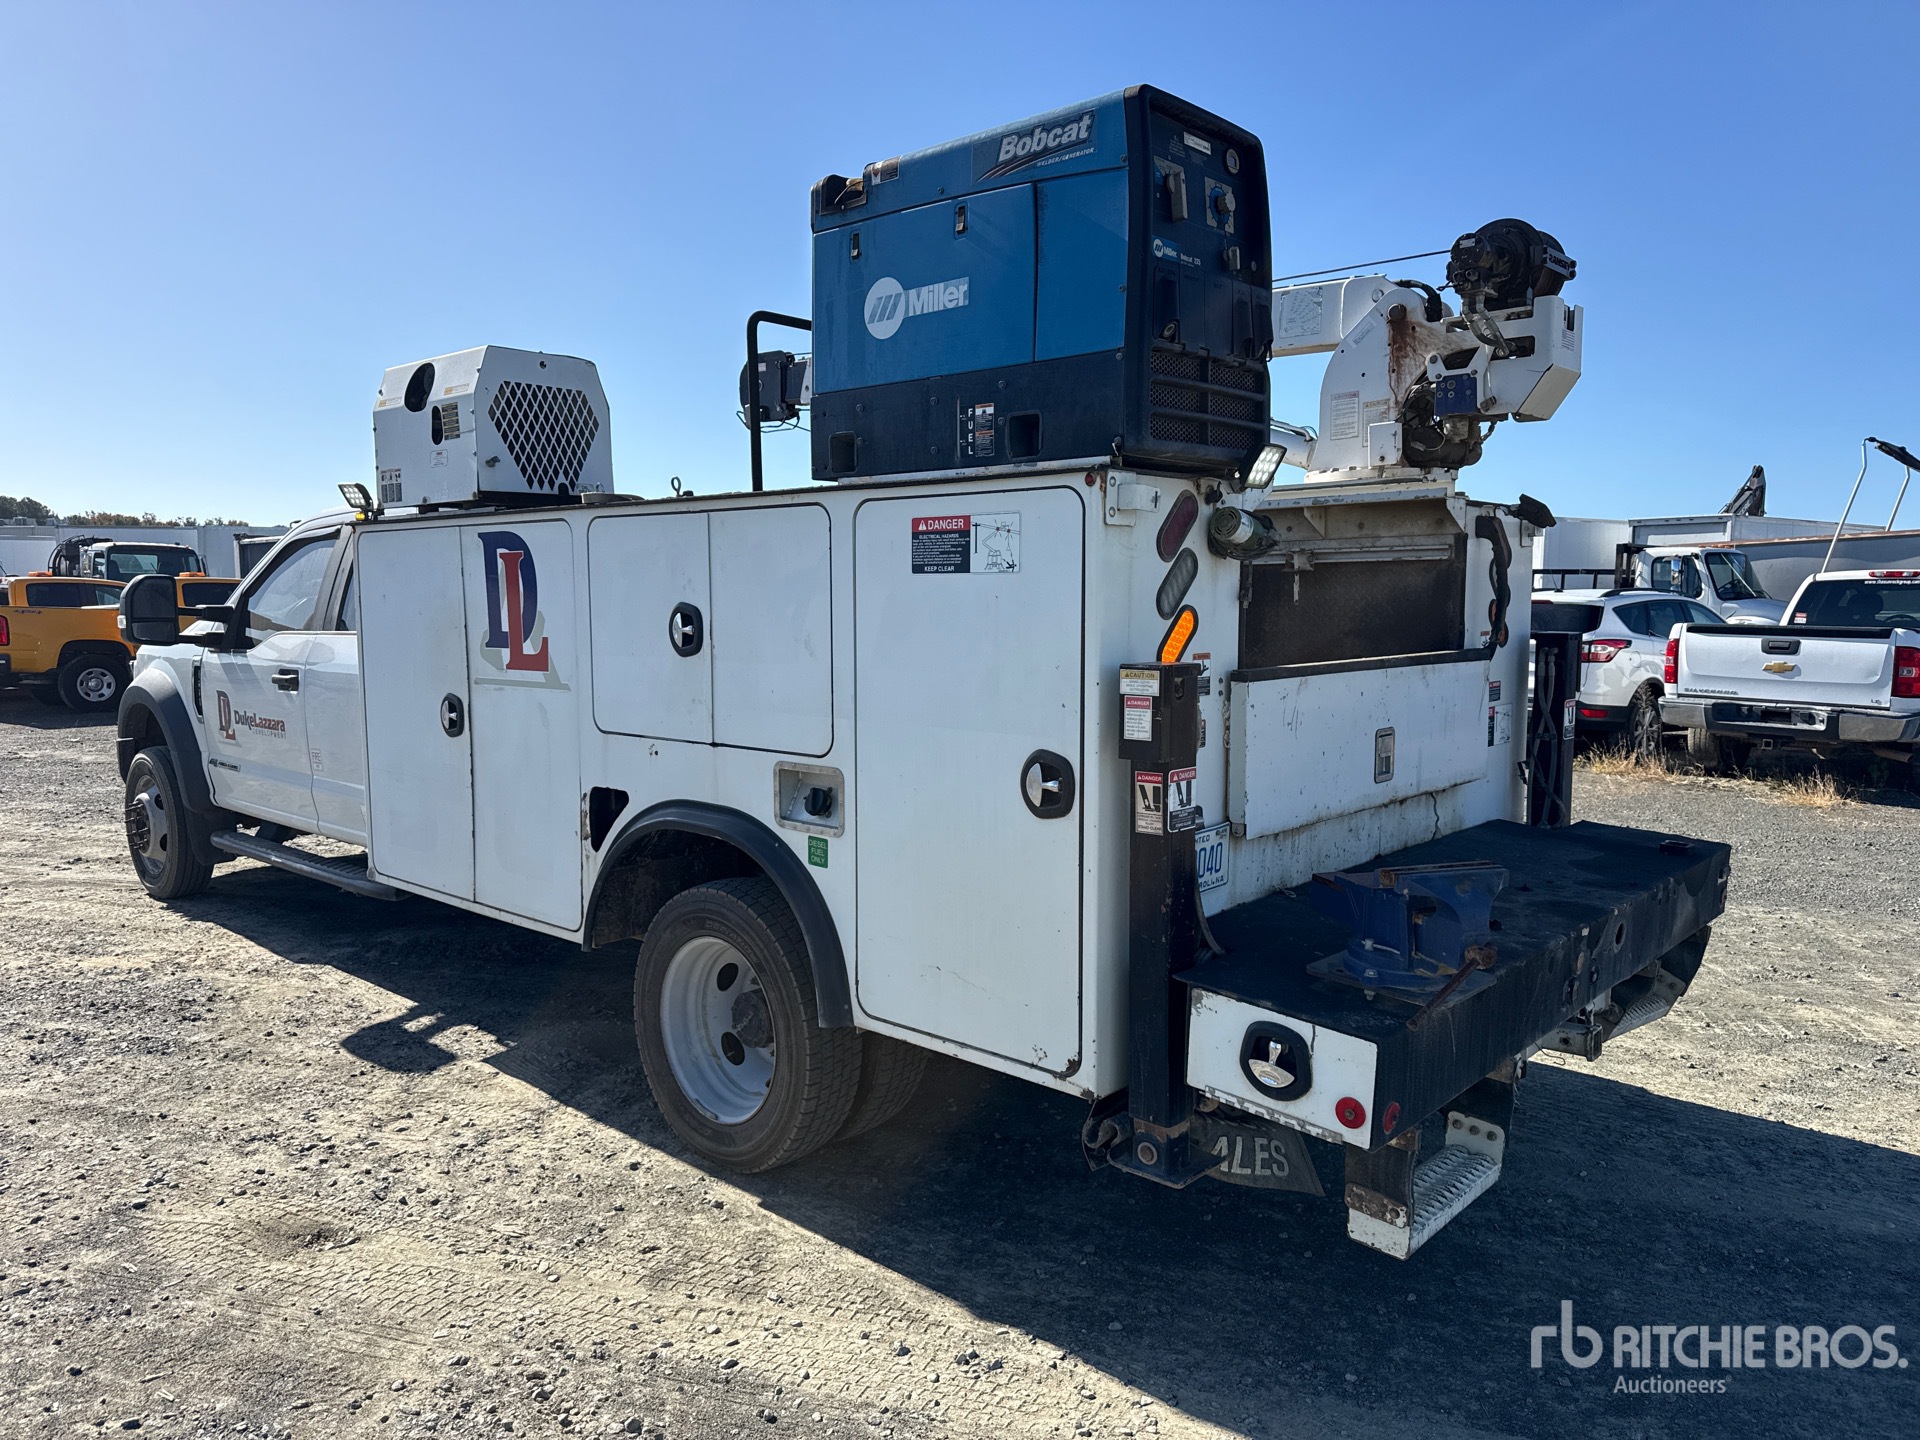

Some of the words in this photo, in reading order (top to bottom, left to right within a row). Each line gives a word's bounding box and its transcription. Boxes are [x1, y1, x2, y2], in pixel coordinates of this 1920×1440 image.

[999, 114, 1091, 161] Bobcat
[908, 283, 968, 317] Miller
[927, 518, 964, 530] DANGER
[234, 710, 286, 733] DukeLazzara
[1178, 770, 1196, 779] DANGER
[809, 839, 828, 849] DIESEL
[811, 847, 825, 857] FUEL
[810, 855, 825, 864] ONLY
[1195, 841, 1223, 879] 040
